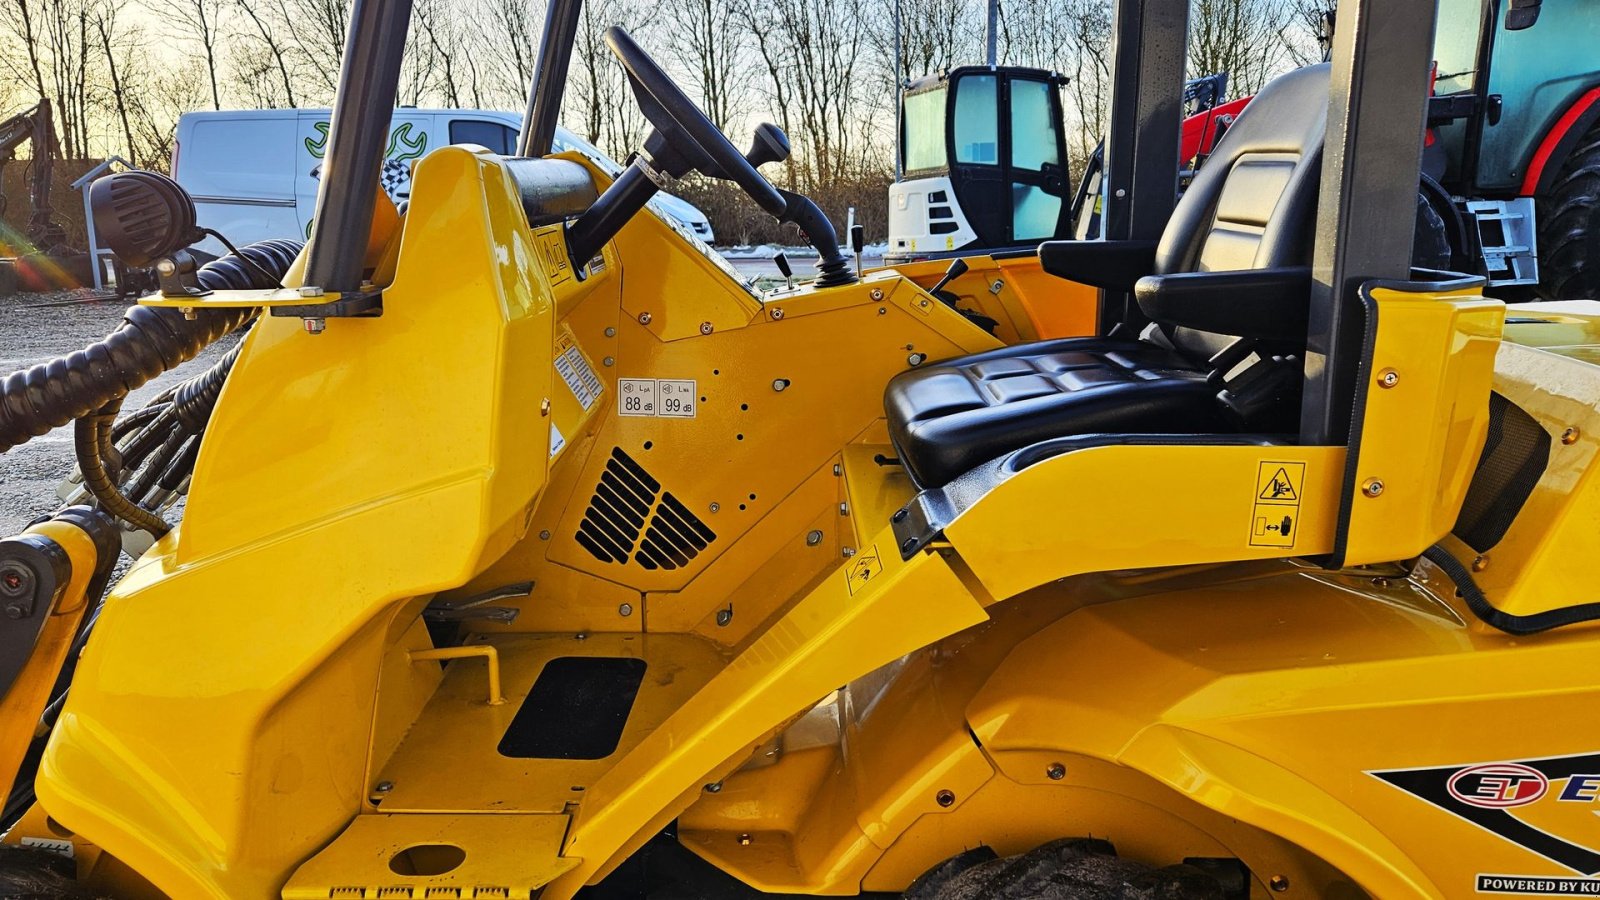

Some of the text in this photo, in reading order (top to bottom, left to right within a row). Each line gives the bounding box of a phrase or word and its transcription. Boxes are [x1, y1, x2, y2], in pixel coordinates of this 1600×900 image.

[625, 396, 653, 411] 88 dB
[665, 398, 692, 412] 99 dB
[1557, 774, 1600, 802] E
[1483, 878, 1556, 891] POWERED
[1559, 881, 1577, 892] BY
